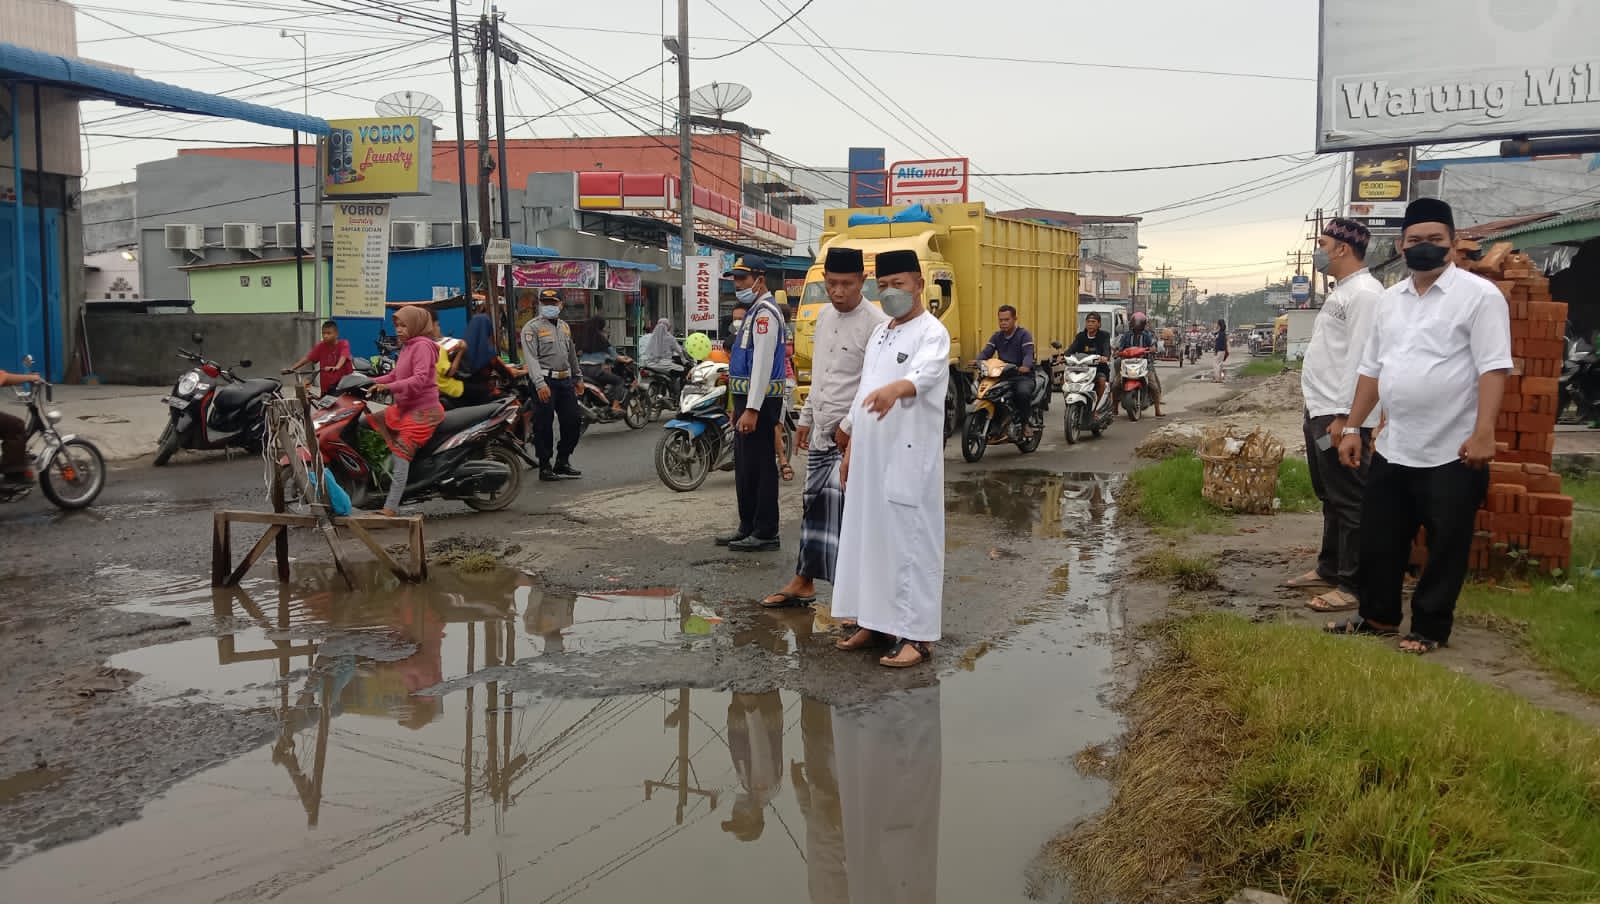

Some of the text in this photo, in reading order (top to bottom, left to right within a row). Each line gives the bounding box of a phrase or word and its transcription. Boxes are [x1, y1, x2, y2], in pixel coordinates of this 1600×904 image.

[1341, 80, 1514, 119] Warung
[358, 124, 415, 144] YOBRO
[359, 146, 413, 172] Laundry
[897, 166, 958, 179] Alfamart
[340, 204, 384, 216] YOBRO
[696, 262, 710, 312] PANGKAS
